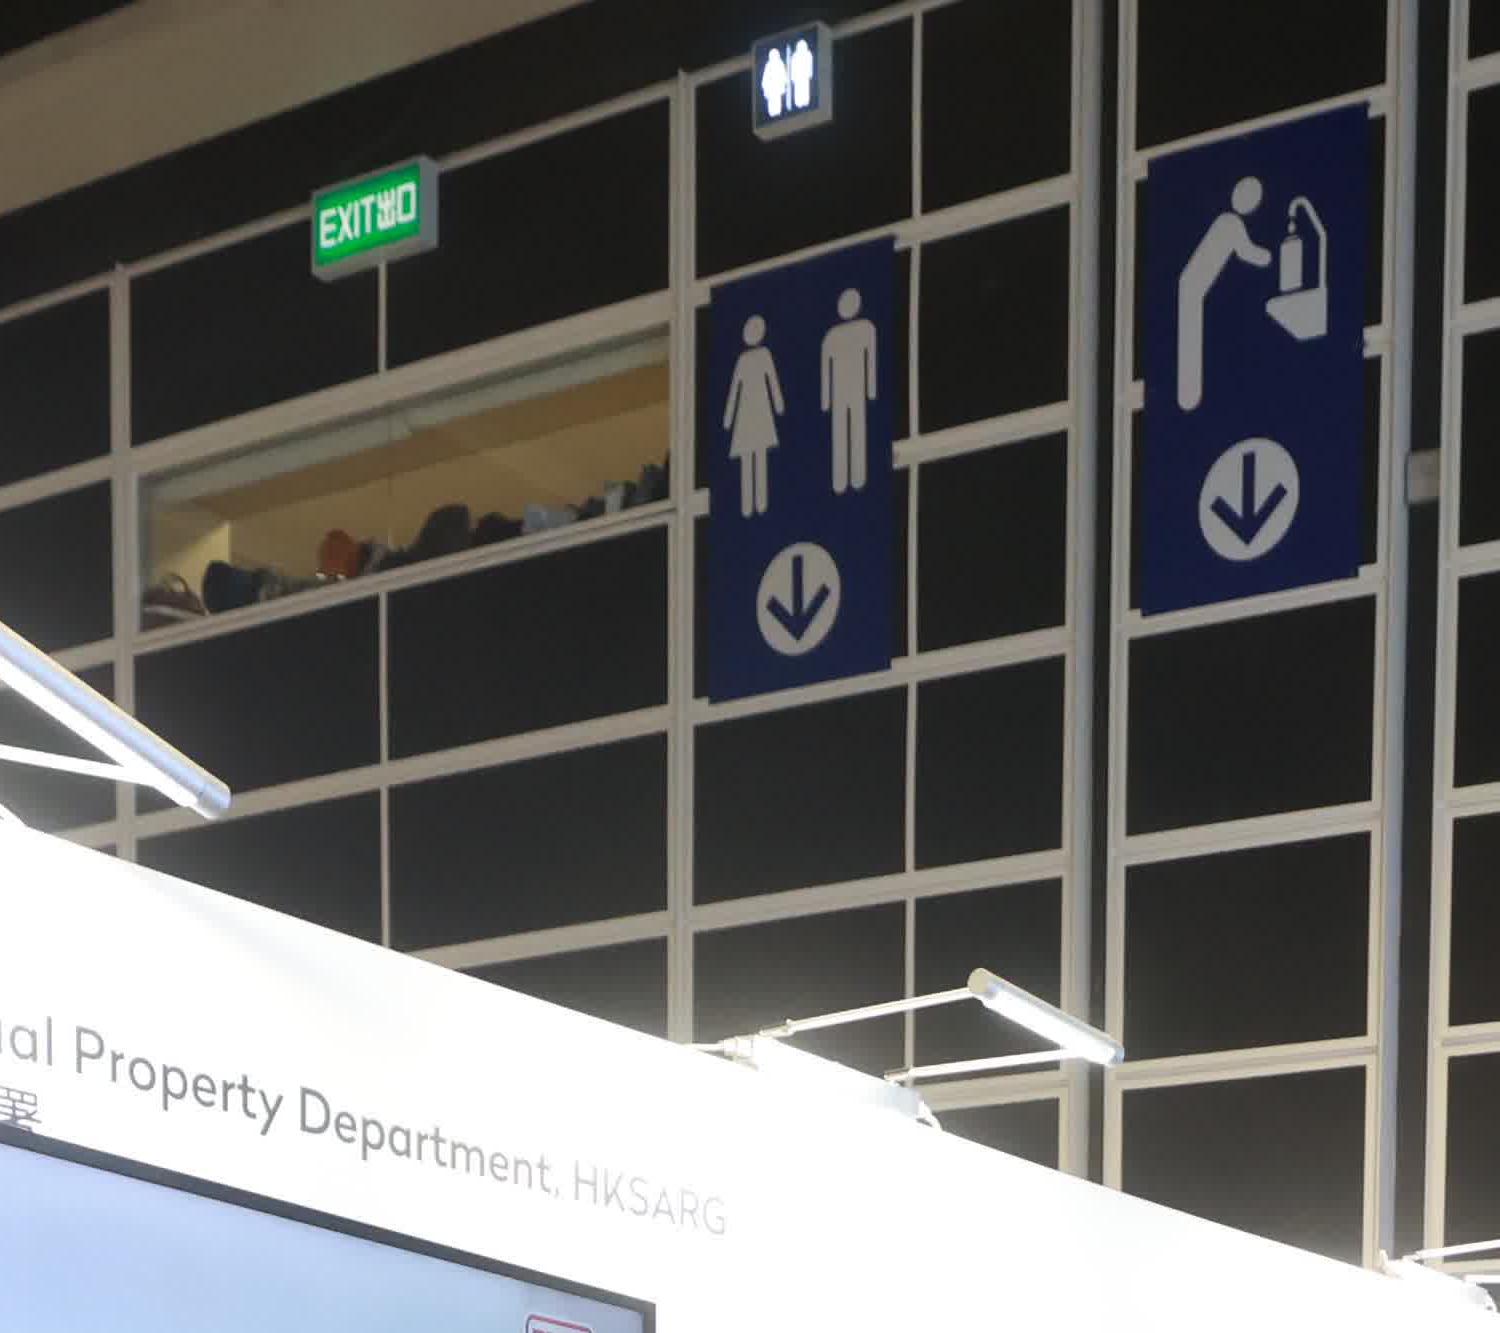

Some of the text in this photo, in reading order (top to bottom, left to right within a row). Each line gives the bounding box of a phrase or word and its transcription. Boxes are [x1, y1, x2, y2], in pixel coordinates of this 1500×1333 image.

[318, 193, 376, 249] EXIT
[376, 180, 417, 231] 出口
[74, 1026, 284, 1135] Property
[298, 1086, 561, 1200] Department,
[572, 1160, 727, 1236] HKSARG
